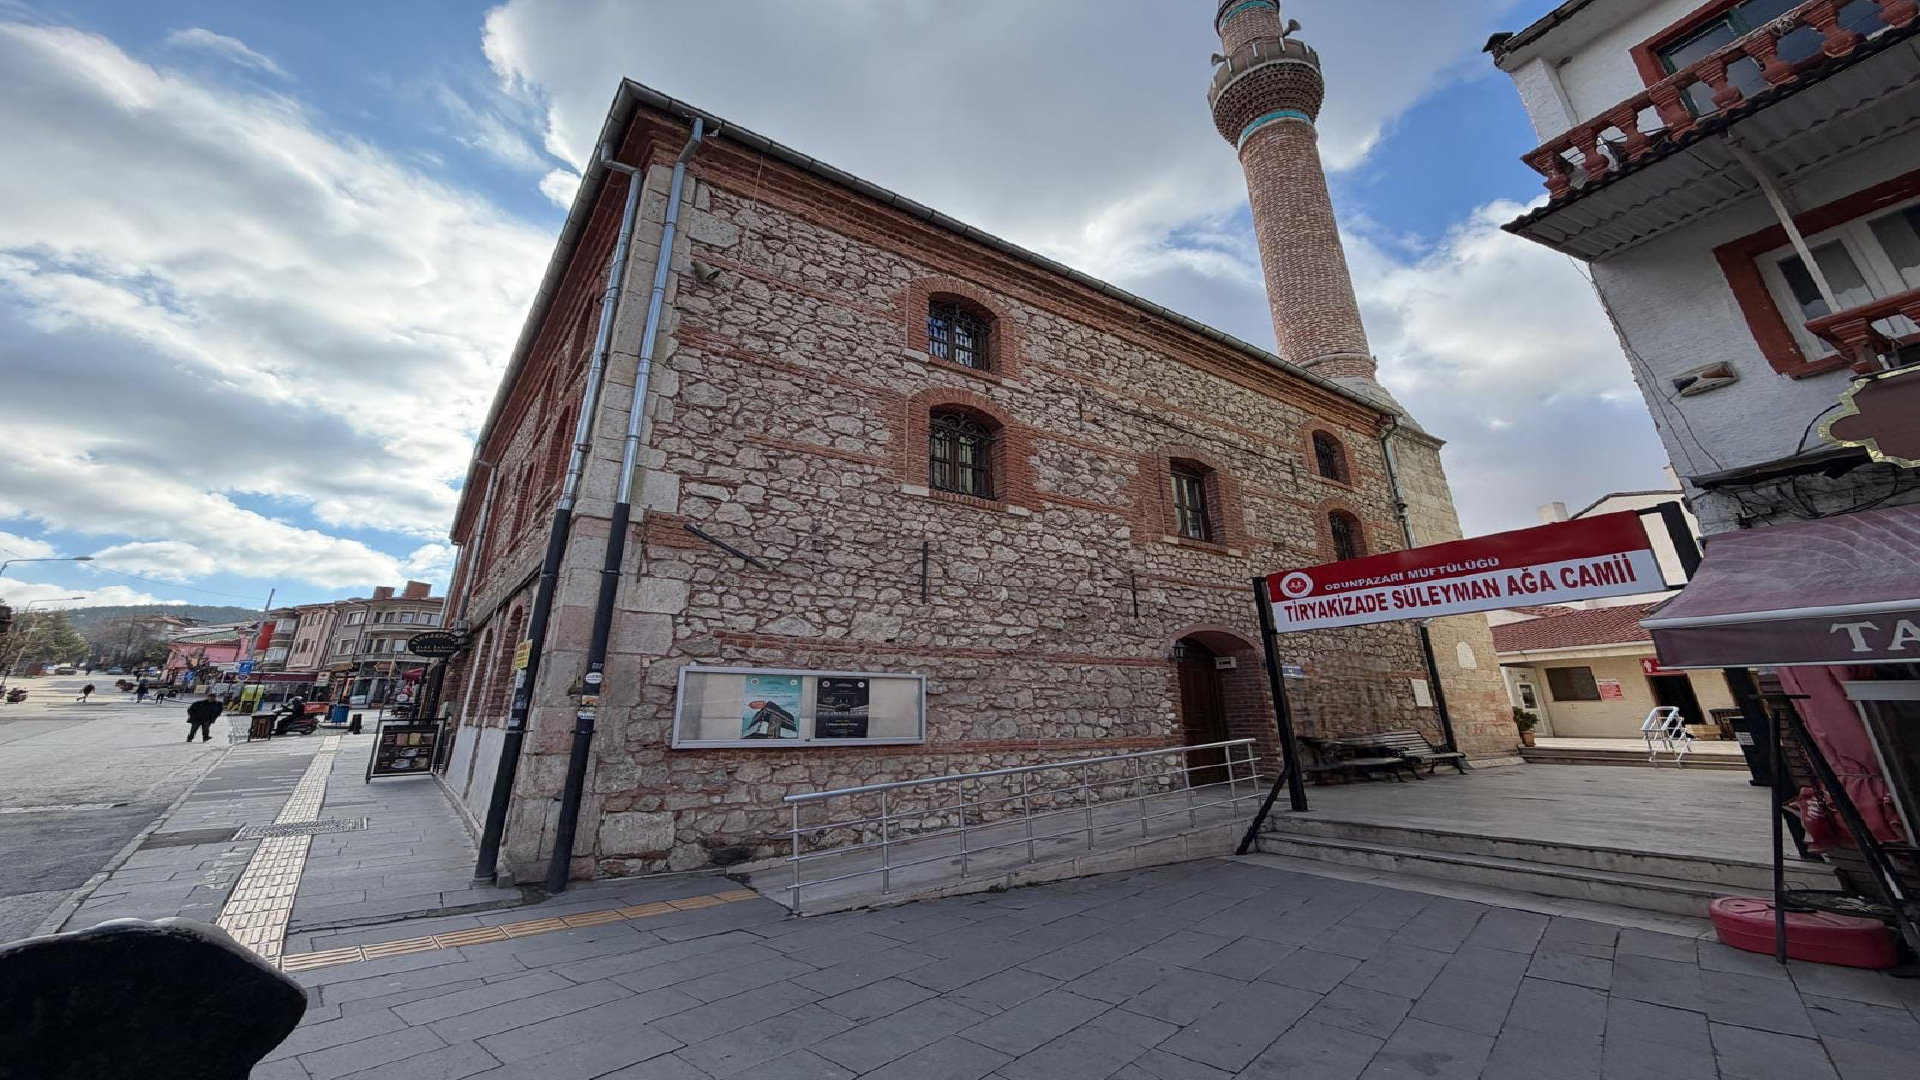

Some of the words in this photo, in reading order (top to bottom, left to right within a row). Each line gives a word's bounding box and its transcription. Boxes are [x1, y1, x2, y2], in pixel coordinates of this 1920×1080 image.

[1284, 593, 1389, 622] TİRYAKİZADE
[1392, 577, 1502, 609] SÜLEYMAN
[1507, 567, 1557, 596] AĞA
[1559, 553, 1637, 589] CAMİİ
[1324, 571, 1404, 591] ODUNPAZARI
[1407, 557, 1500, 580] MÜFTÜLÜĞÜ
